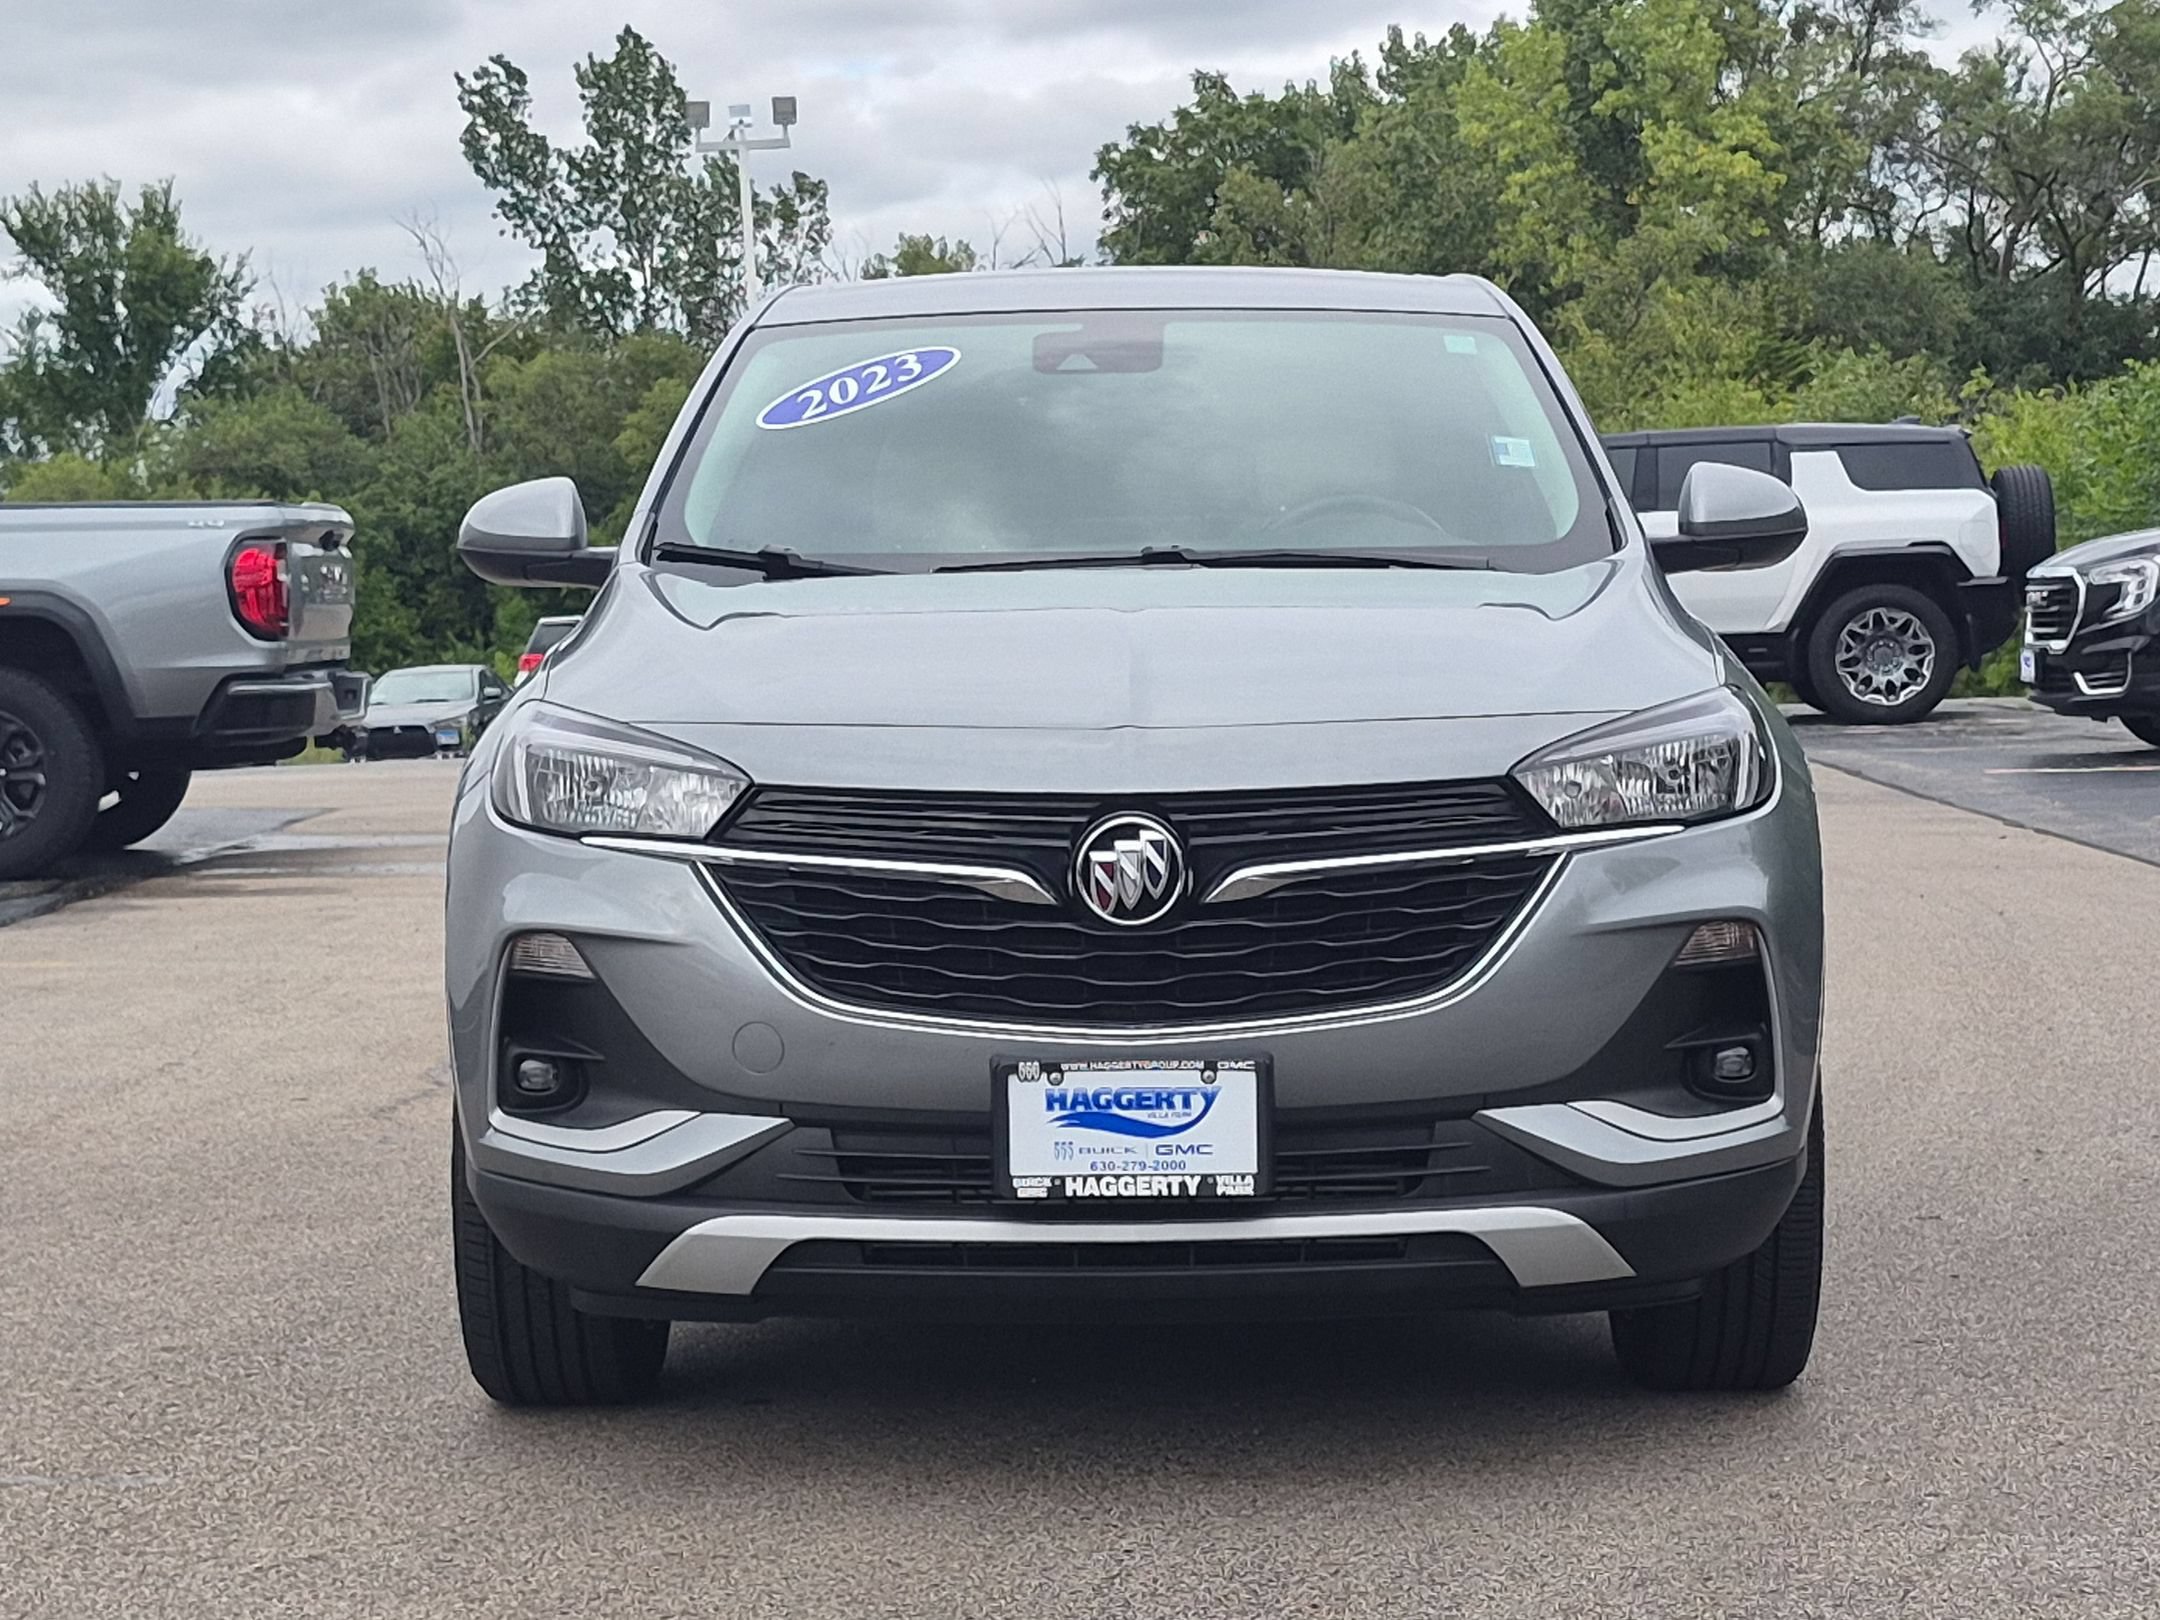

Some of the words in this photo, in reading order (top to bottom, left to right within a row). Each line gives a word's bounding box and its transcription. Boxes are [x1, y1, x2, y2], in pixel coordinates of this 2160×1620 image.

[797, 353, 922, 419] 2023
[1045, 1086, 1222, 1112] HAGGERTY
[1078, 1146, 1138, 1155] BUICK
[1155, 1144, 1214, 1156] GMC
[1090, 1160, 1187, 1172] 630-279-2000
[1216, 1174, 1254, 1186] VILLA
[1065, 1176, 1202, 1197] HAGGERTY
